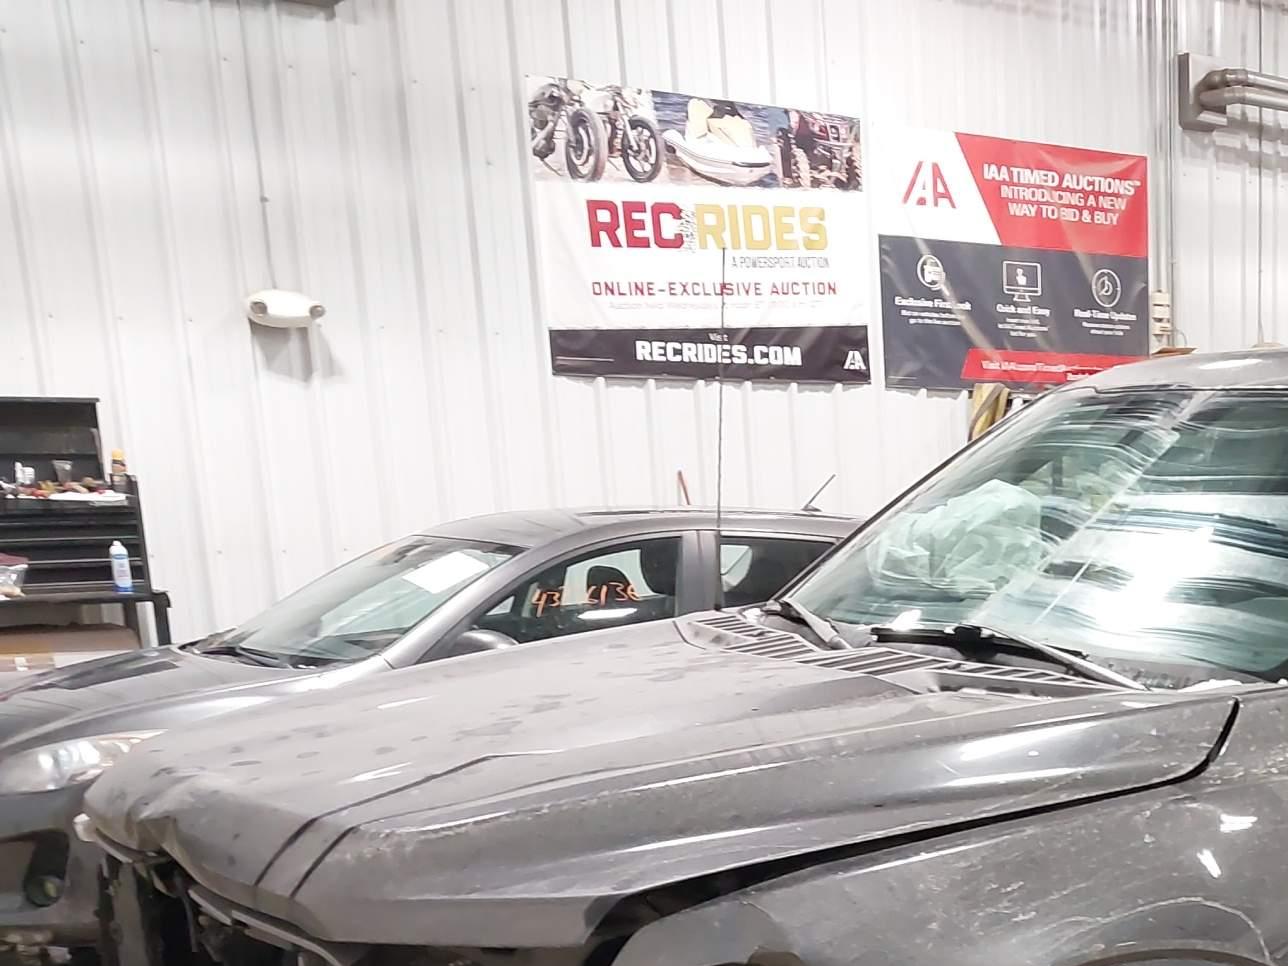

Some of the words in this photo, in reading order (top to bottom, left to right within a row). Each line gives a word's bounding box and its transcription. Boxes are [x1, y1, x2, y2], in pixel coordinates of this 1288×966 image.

[983, 163, 1009, 182] IAA
[1010, 166, 1059, 187] TIMED
[1000, 185, 1085, 207] INTRODUCING
[1087, 195, 1097, 207] A
[1098, 196, 1127, 210] NEW
[585, 199, 684, 249] REC
[694, 203, 828, 250] RIDES
[1008, 203, 1038, 217] WAY
[1040, 204, 1058, 219] TO
[1060, 208, 1079, 222] BID
[1081, 210, 1091, 223] &
[1094, 211, 1120, 225] BUY
[591, 281, 763, 297] ONLINE-EXCLUSIVE
[769, 281, 837, 296] AUCTION
[635, 340, 802, 366] RECRIDES.COM
